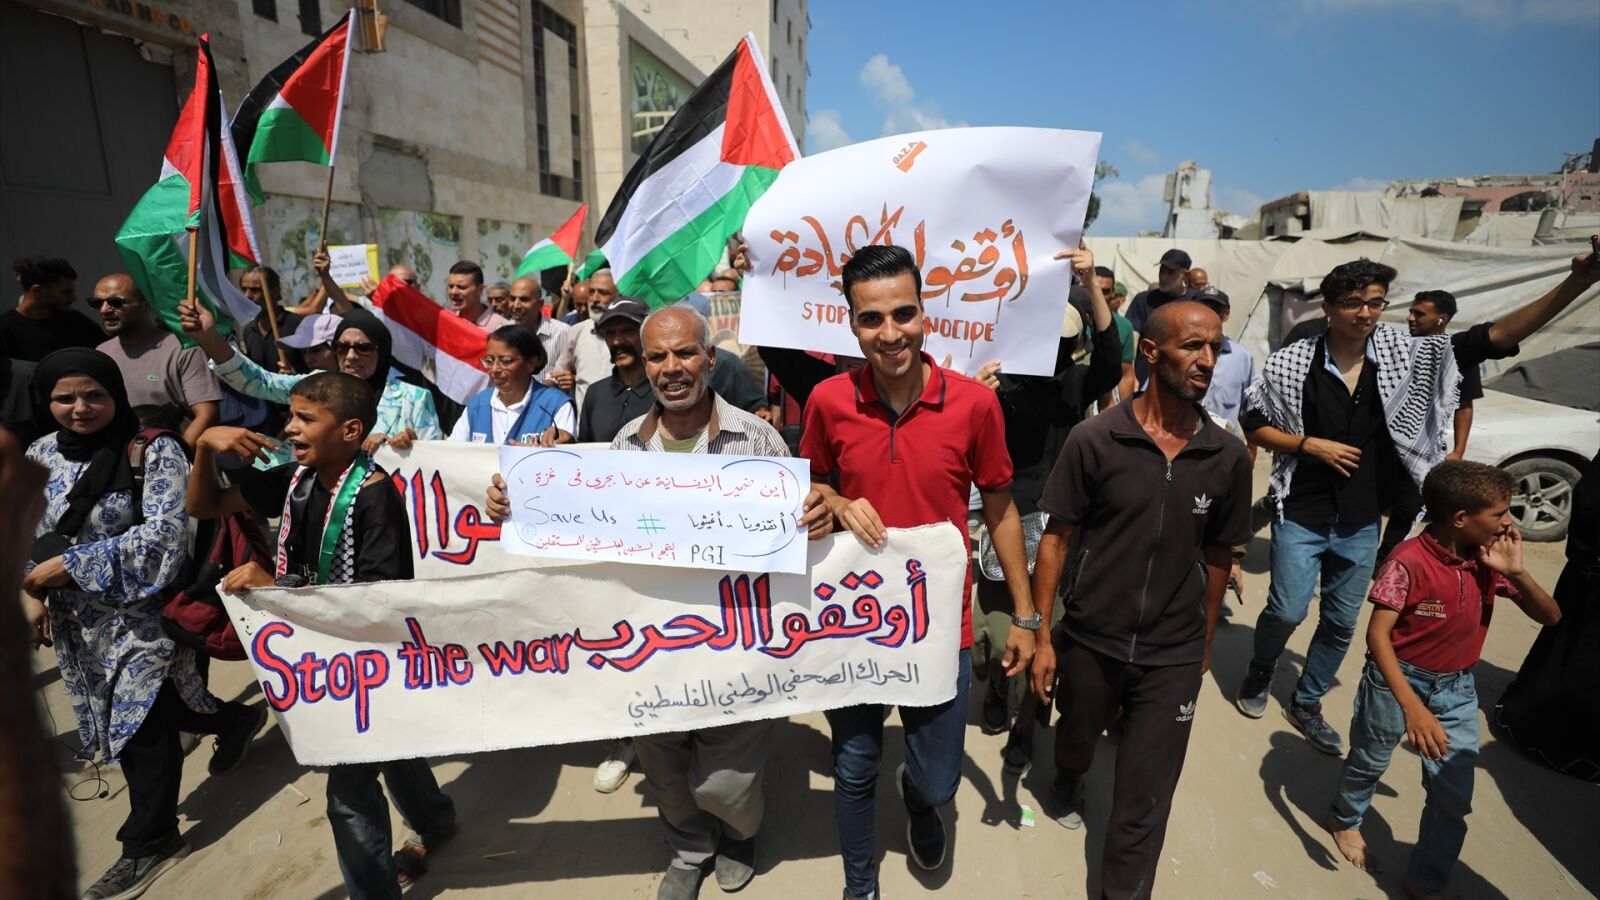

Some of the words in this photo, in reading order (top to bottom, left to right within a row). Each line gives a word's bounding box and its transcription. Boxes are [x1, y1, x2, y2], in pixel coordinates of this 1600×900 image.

[801, 302, 848, 325] STOP
[922, 316, 995, 342] NOCIDE
[523, 496, 584, 525] Save
[591, 507, 617, 524] Us
[691, 544, 726, 565] PGI
[574, 573, 751, 673] الحرب
[753, 559, 931, 659] أوقفوا
[252, 621, 390, 733] Stop
[398, 617, 474, 690] the
[478, 633, 572, 676] war
[781, 661, 854, 700] الصحفي
[855, 658, 920, 686] الحراك
[628, 679, 715, 727] الفلسطيني
[718, 672, 782, 715] الوطني
